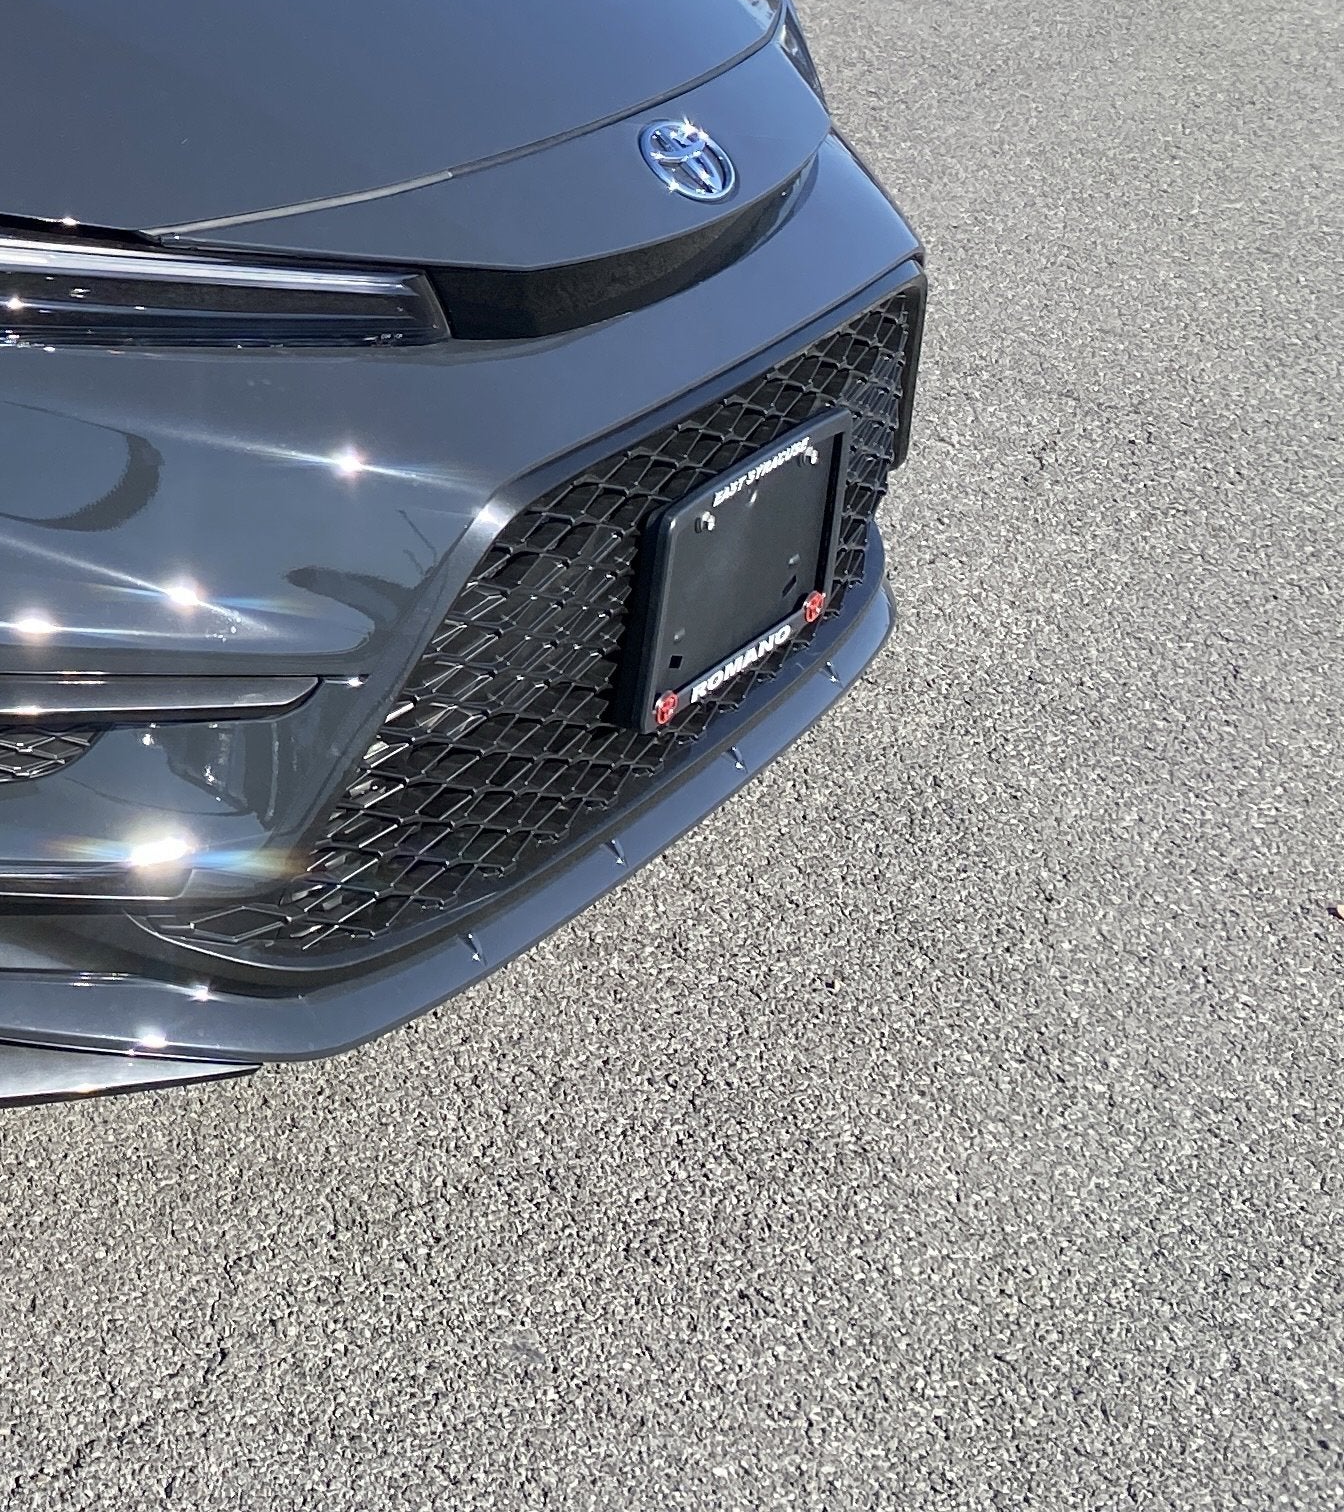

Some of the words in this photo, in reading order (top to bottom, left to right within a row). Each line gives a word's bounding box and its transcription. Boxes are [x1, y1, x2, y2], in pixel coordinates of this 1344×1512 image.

[713, 475, 747, 508] EAST
[746, 437, 809, 485] SYRACUSE
[691, 624, 791, 704] ROMANO
